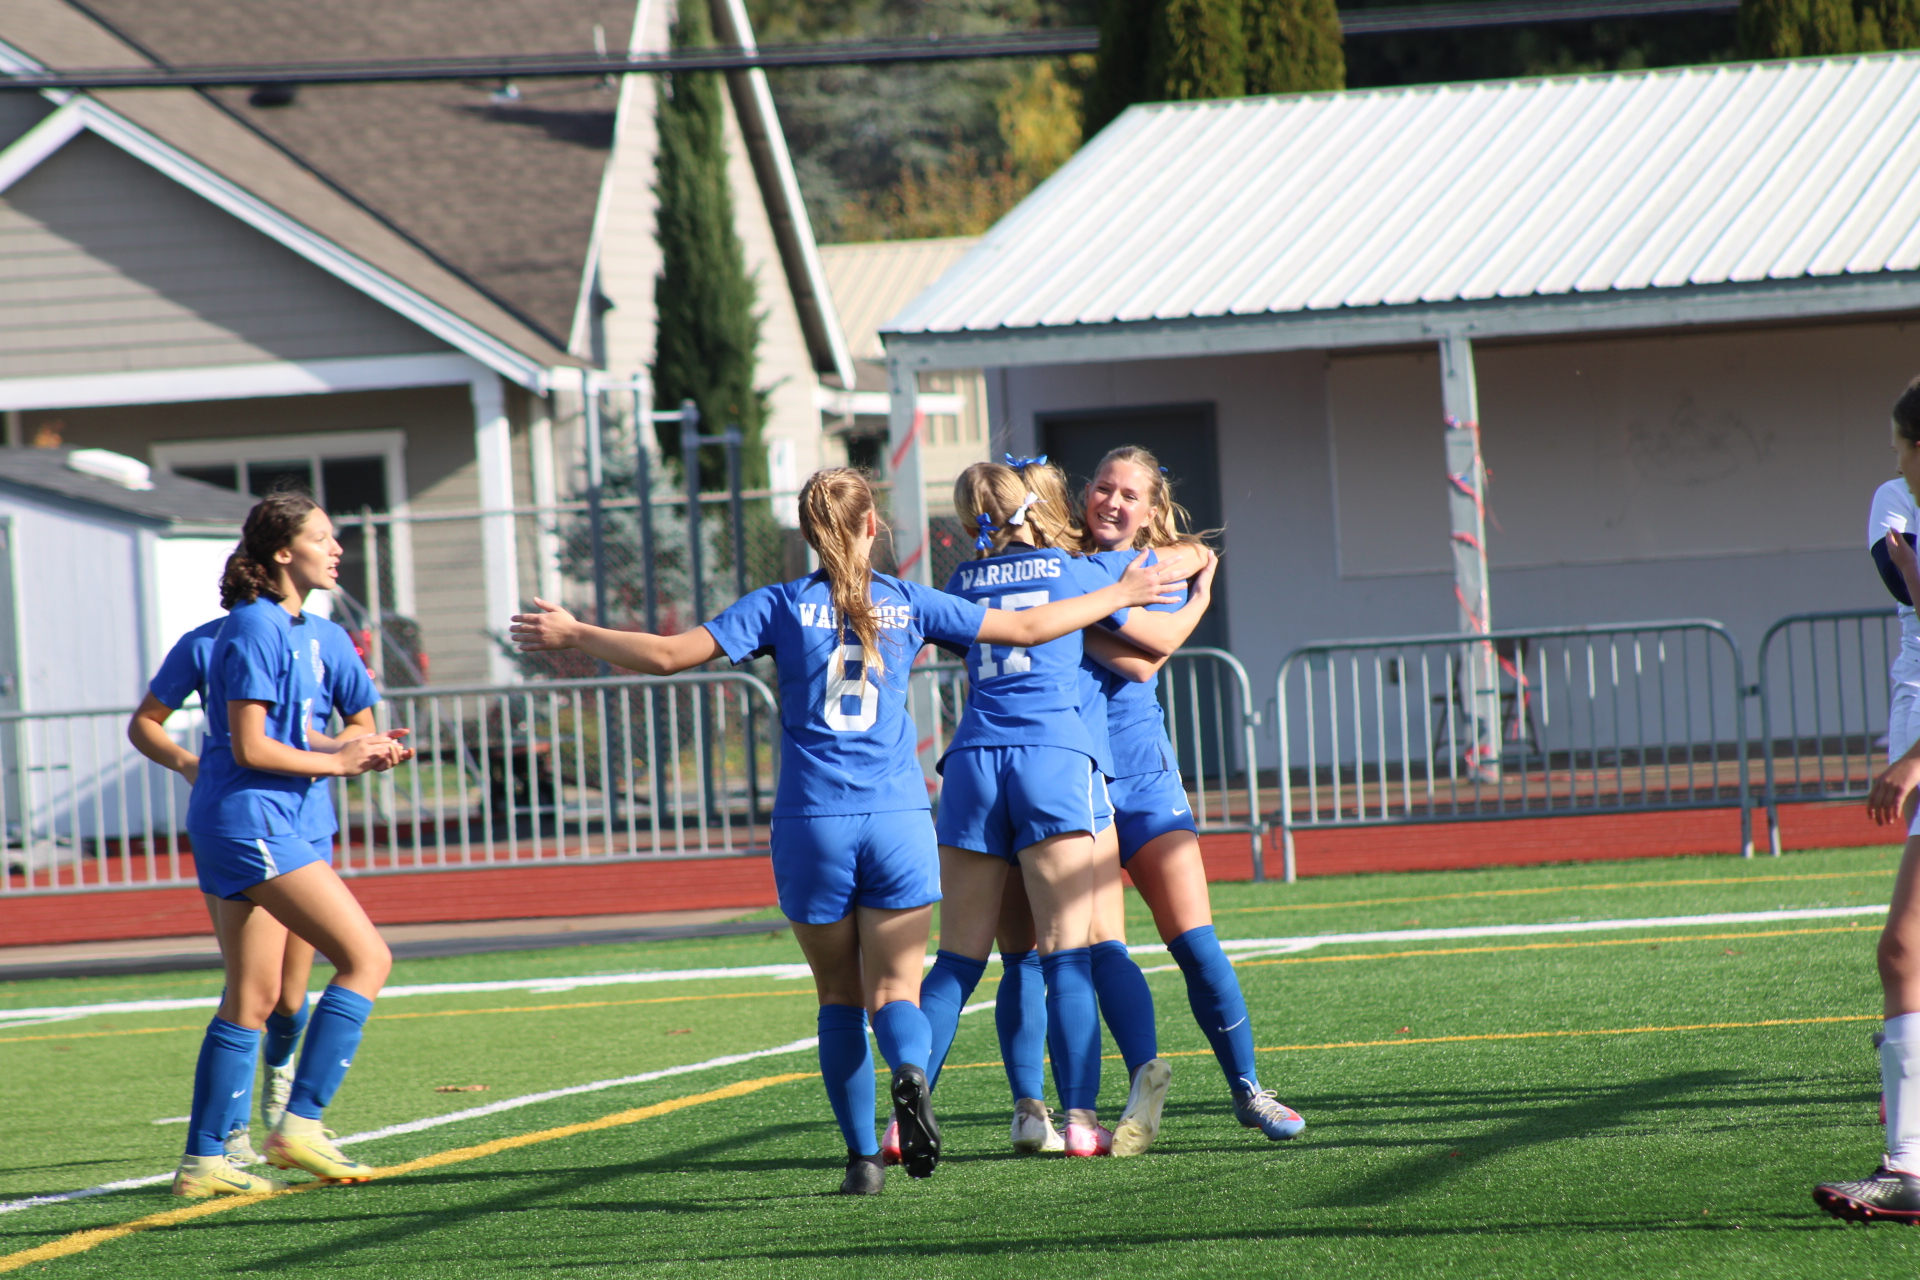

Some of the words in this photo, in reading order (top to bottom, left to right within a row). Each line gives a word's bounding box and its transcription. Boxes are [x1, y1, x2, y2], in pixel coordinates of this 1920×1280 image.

[960, 558, 1061, 591] WARRIORS
[799, 603, 910, 629] WAORS
[976, 590, 1049, 680] 17
[824, 645, 879, 731] 6
